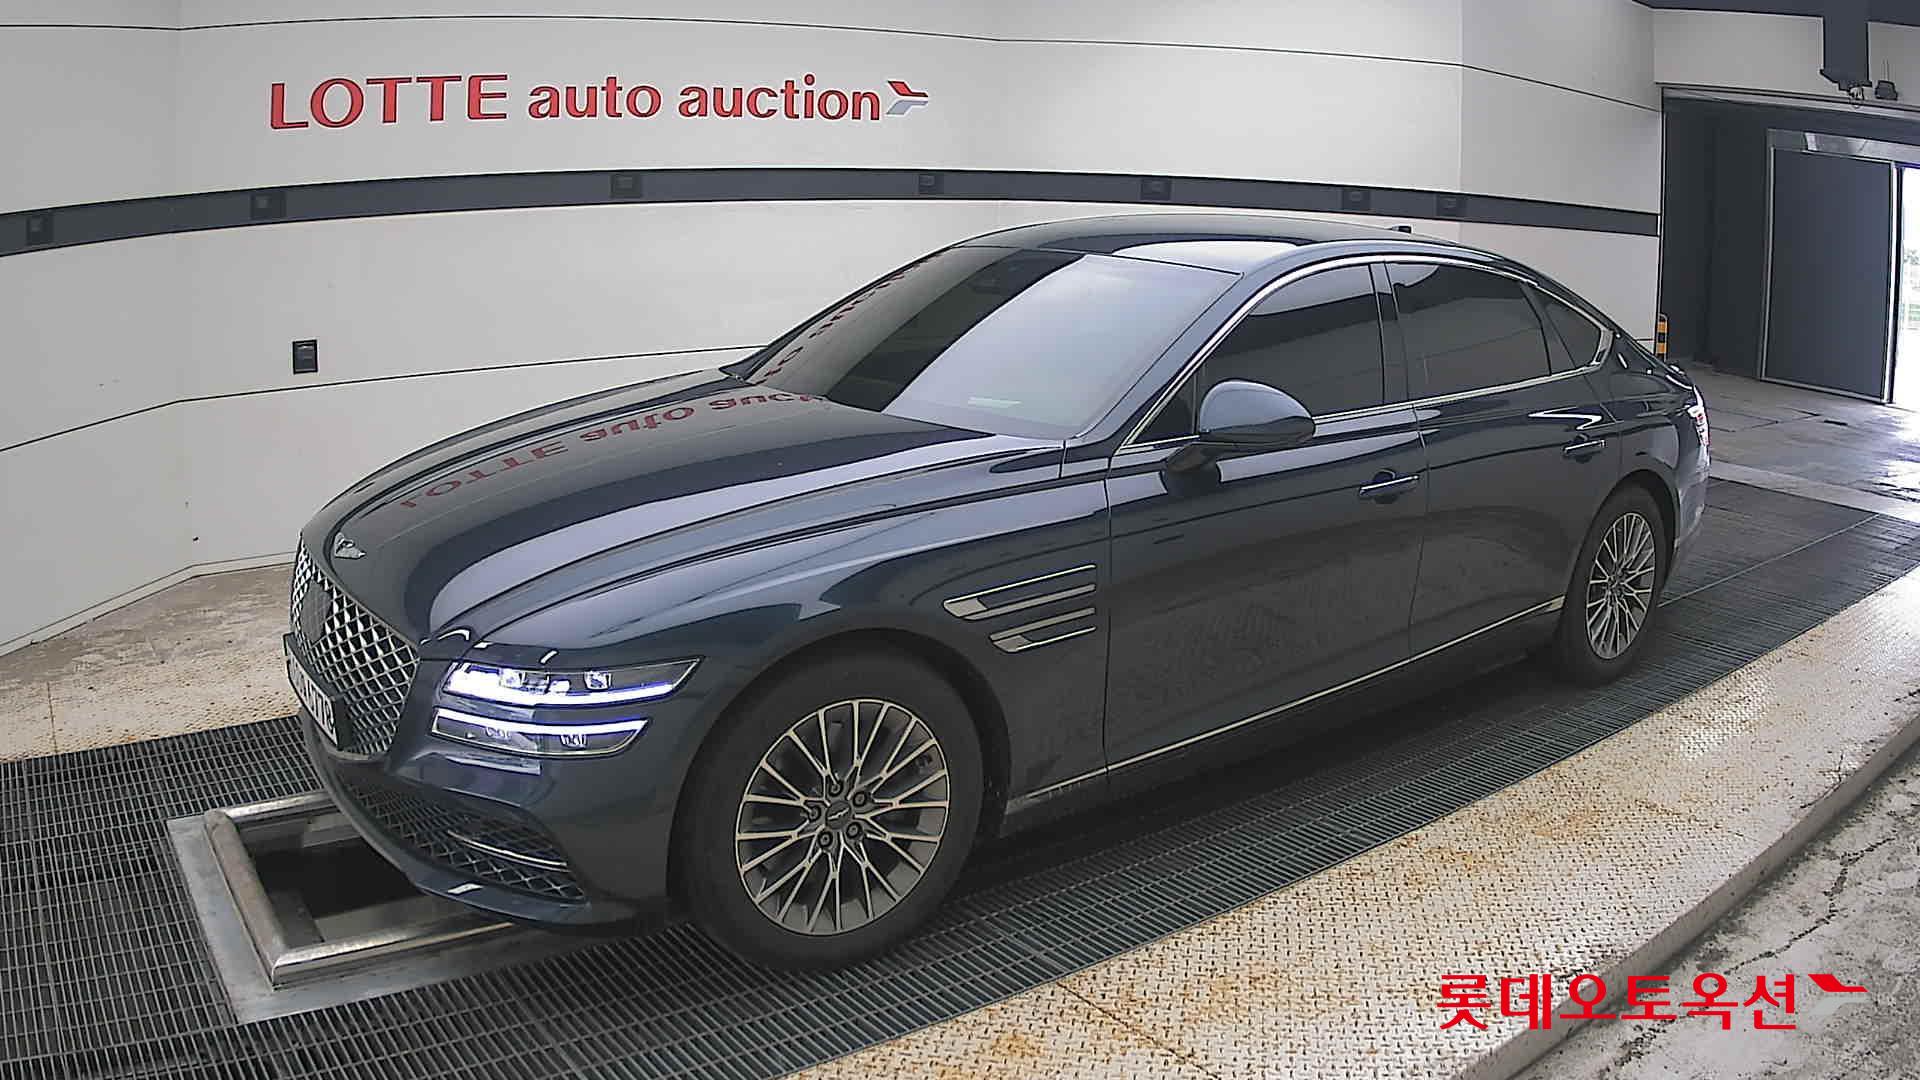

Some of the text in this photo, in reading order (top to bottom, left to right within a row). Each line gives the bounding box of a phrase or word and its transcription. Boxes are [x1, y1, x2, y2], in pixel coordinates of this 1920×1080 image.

[270, 74, 881, 129] LOTTE auto auction
